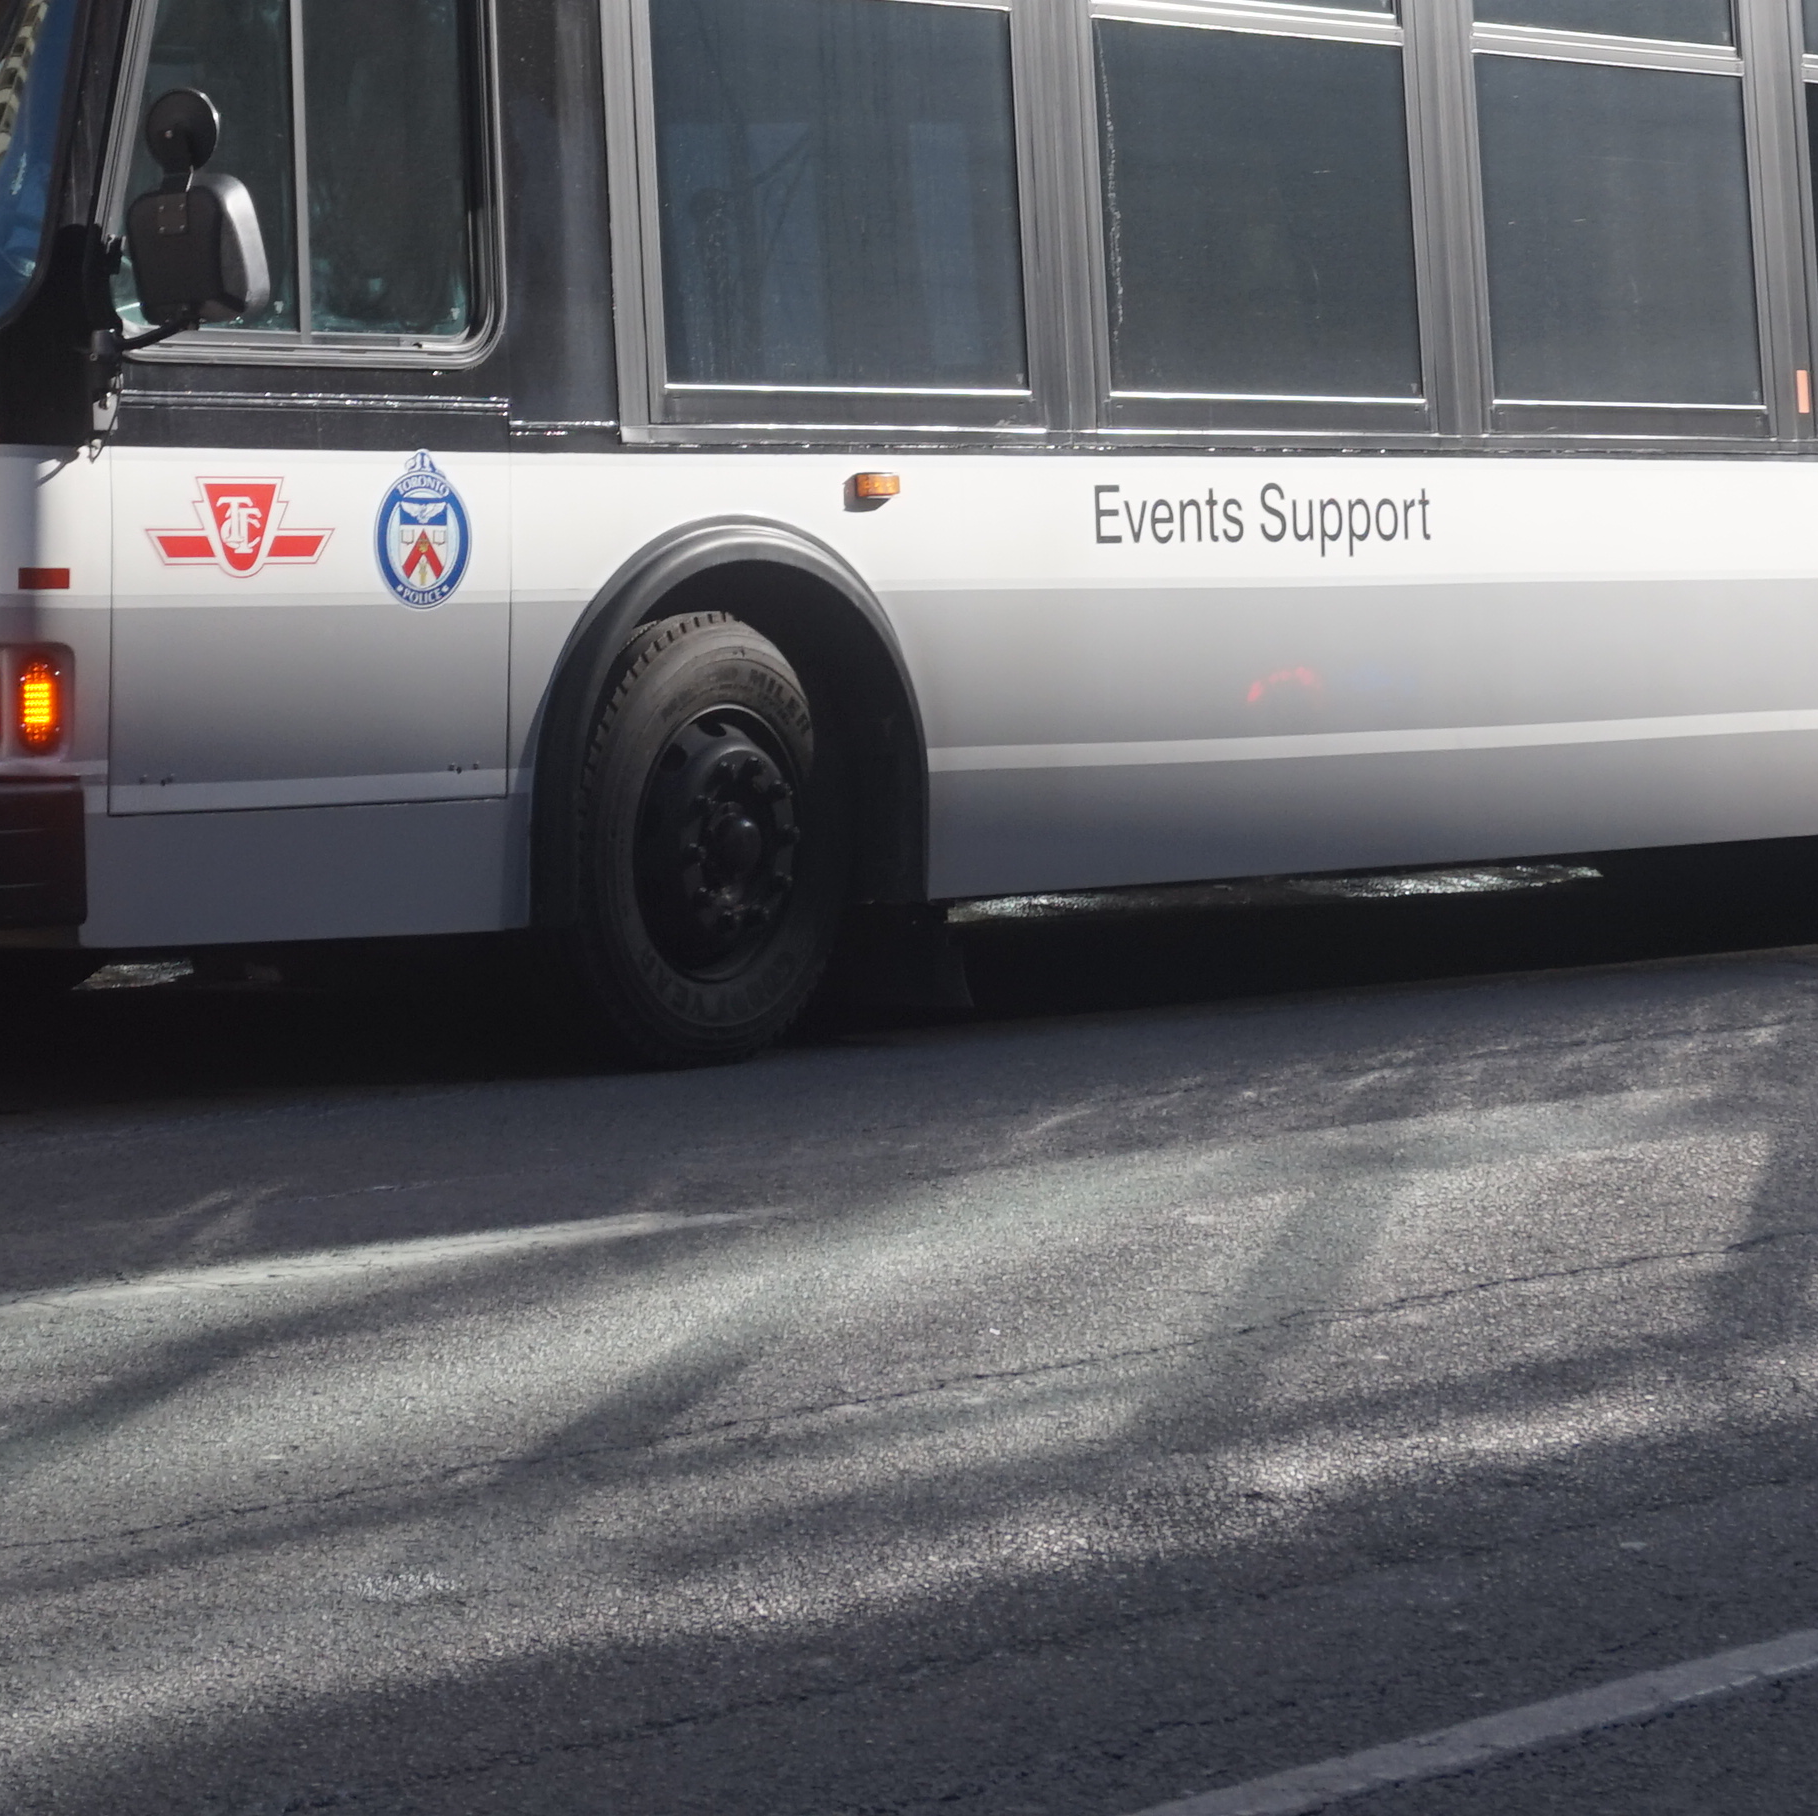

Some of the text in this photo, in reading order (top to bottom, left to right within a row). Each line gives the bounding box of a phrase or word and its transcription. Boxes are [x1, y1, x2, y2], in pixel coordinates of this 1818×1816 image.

[396, 474, 450, 497] TORONTO
[1094, 482, 1432, 558] Events Support
[403, 588, 443, 604] POLICE
